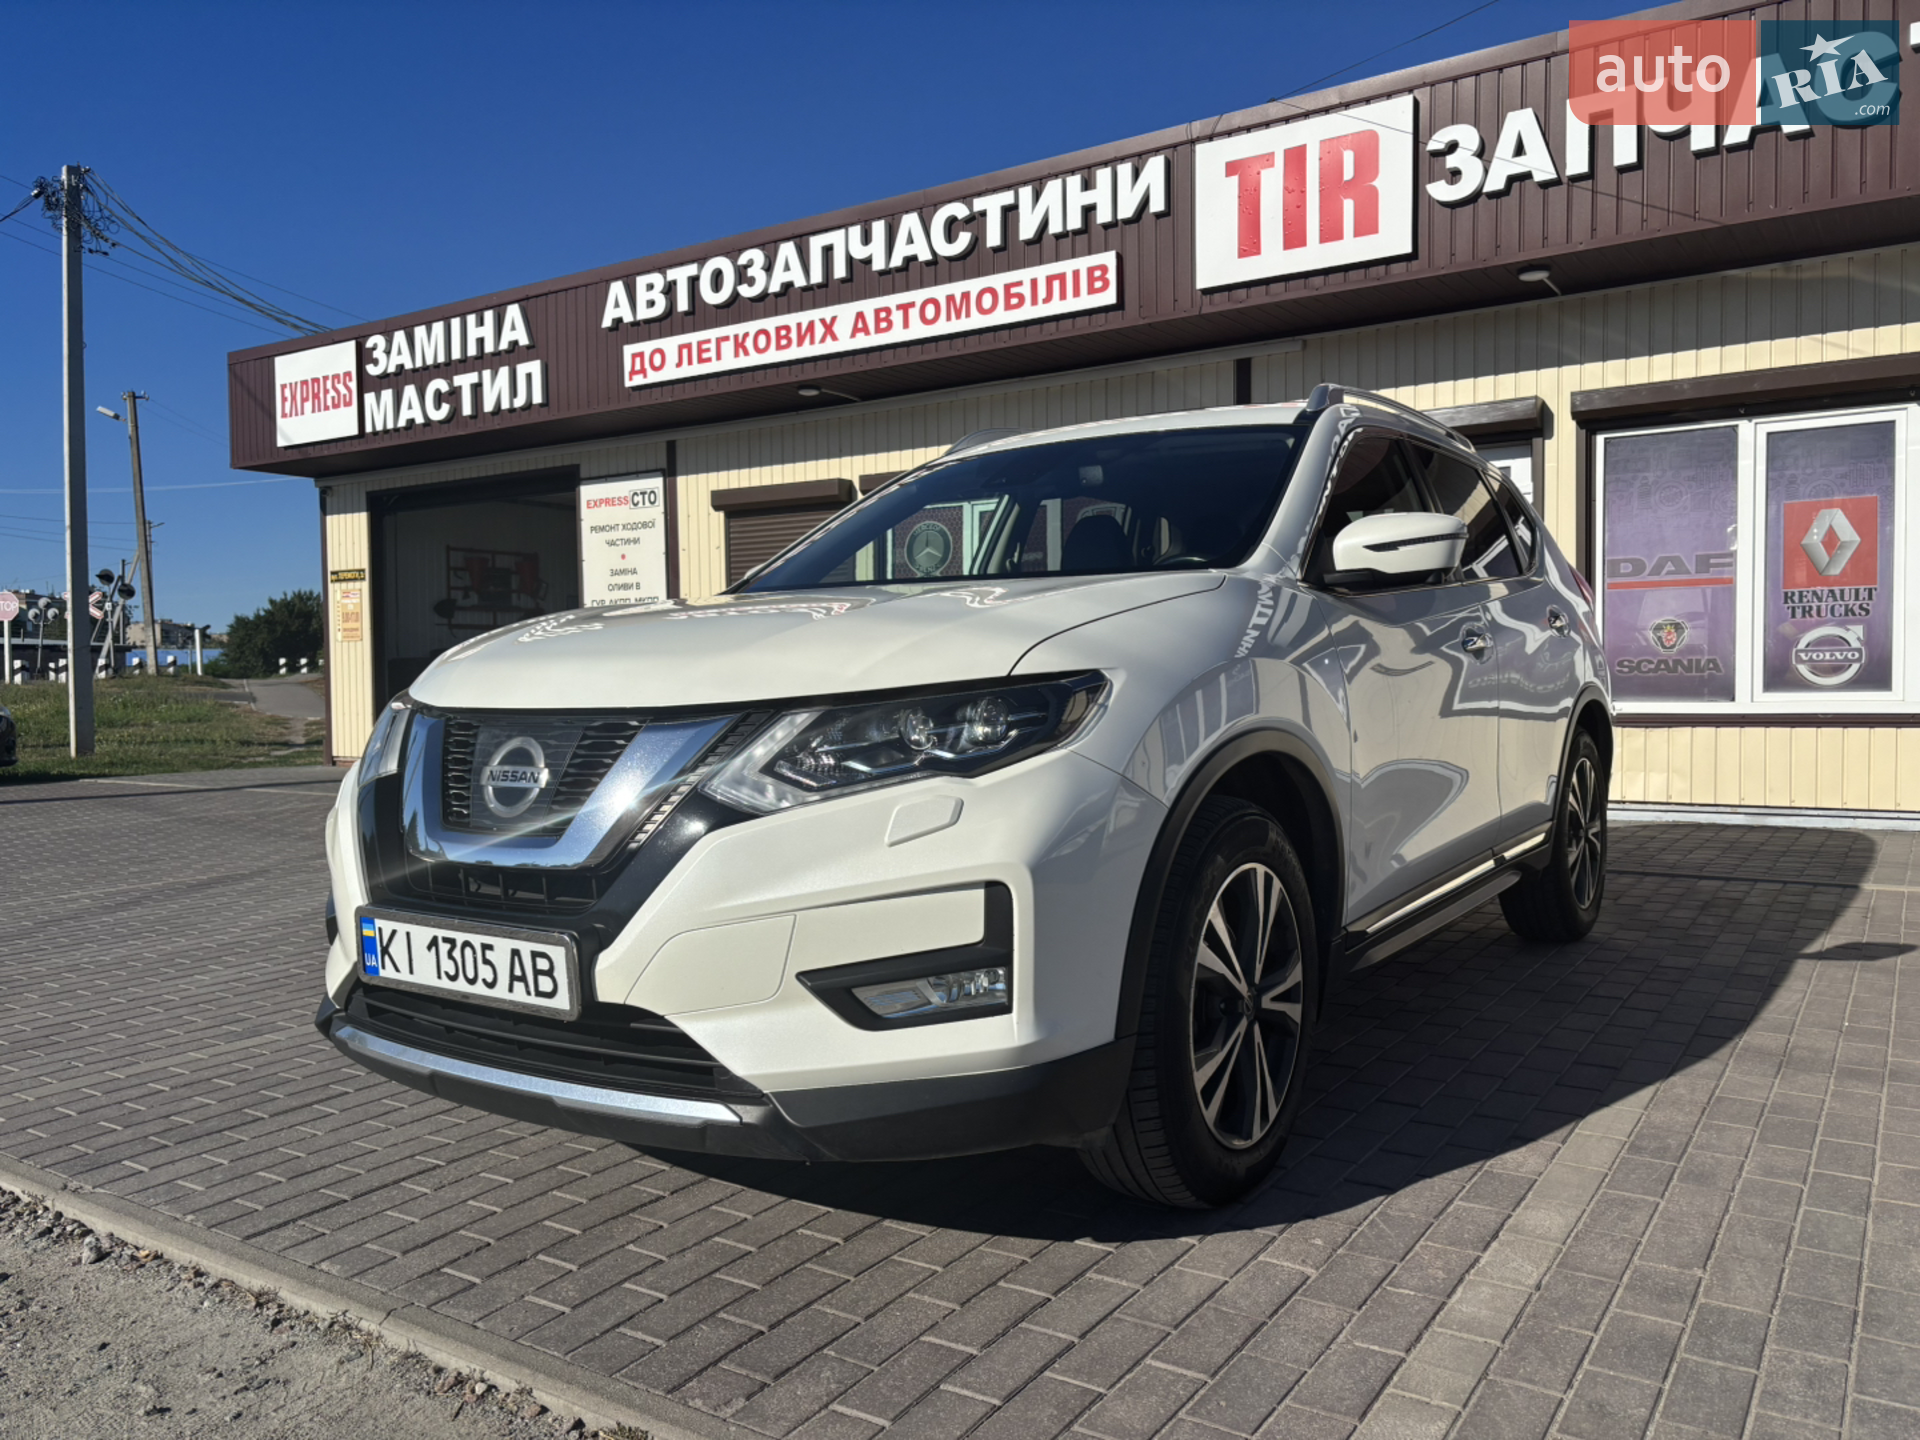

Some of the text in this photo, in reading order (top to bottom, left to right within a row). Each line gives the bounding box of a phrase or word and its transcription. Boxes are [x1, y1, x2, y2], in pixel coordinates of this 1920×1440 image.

[1425, 21, 1920, 204] ЗАПЧАС
[1224, 129, 1380, 259] TIR
[601, 154, 1168, 328] АВТОЗАПЧАСТИНИ
[628, 263, 1111, 382] ДО ЛЕГКОВИХ АВТОМОБІЛІВ
[365, 303, 531, 376] ЗАМІНА
[280, 371, 354, 419] EXPRESS
[364, 360, 543, 433] МАСТИЛ
[586, 490, 657, 510] EXPRESS СТО
[590, 519, 656, 534] РЕМОНТ ХОДОВОЇ
[605, 537, 640, 547] ЧАСТИНИ
[609, 567, 638, 577] ЗАМІНА
[1606, 552, 1734, 578] DAF
[607, 582, 641, 592] ОЛИВИ В
[1783, 587, 1877, 605] RENAULT
[0, 600, 18, 611] TOP
[1787, 602, 1870, 619] TRUCKS
[1798, 651, 1860, 660] VOLVO
[1615, 657, 1723, 675] SCANIA
[487, 769, 540, 784] NISSAN
[364, 952, 378, 968] UA
[378, 926, 558, 999] KI 1305 AB
